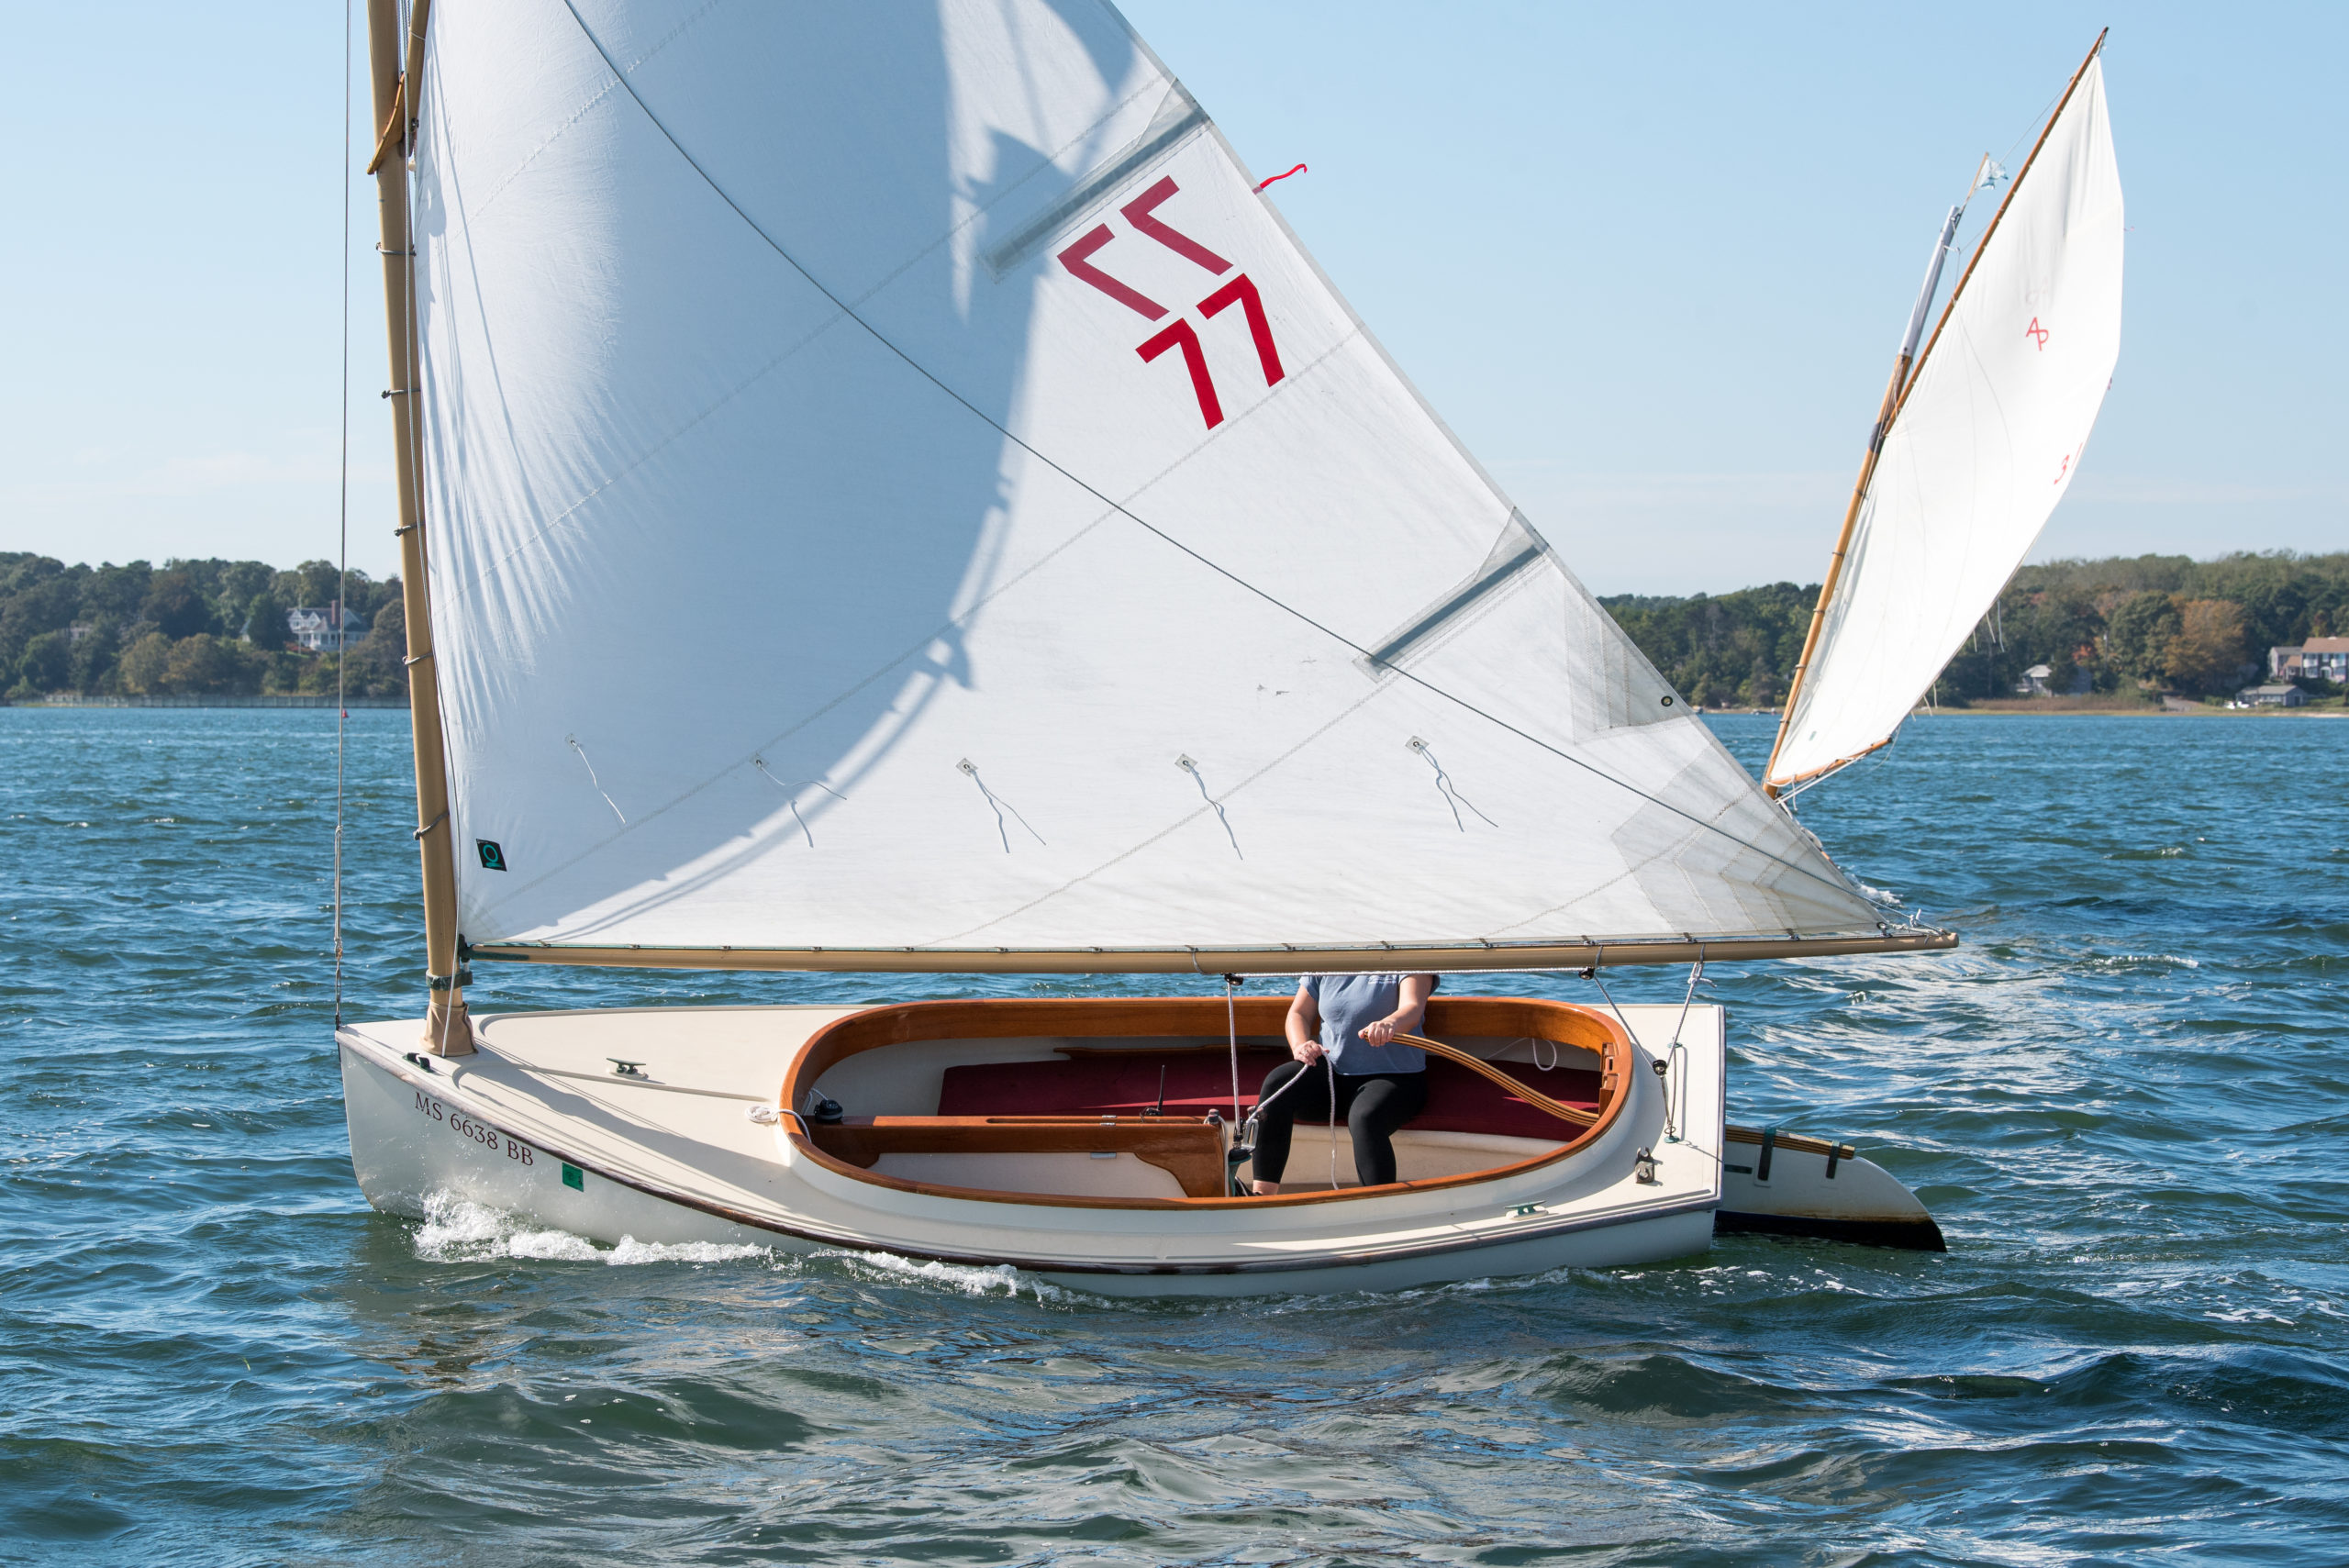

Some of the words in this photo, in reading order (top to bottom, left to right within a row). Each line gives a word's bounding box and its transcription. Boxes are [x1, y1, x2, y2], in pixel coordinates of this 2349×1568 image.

[1135, 272, 1286, 430] 77
[415, 1091, 442, 1121] MS
[450, 1113, 498, 1150] 6638
[506, 1139, 534, 1166] BB
